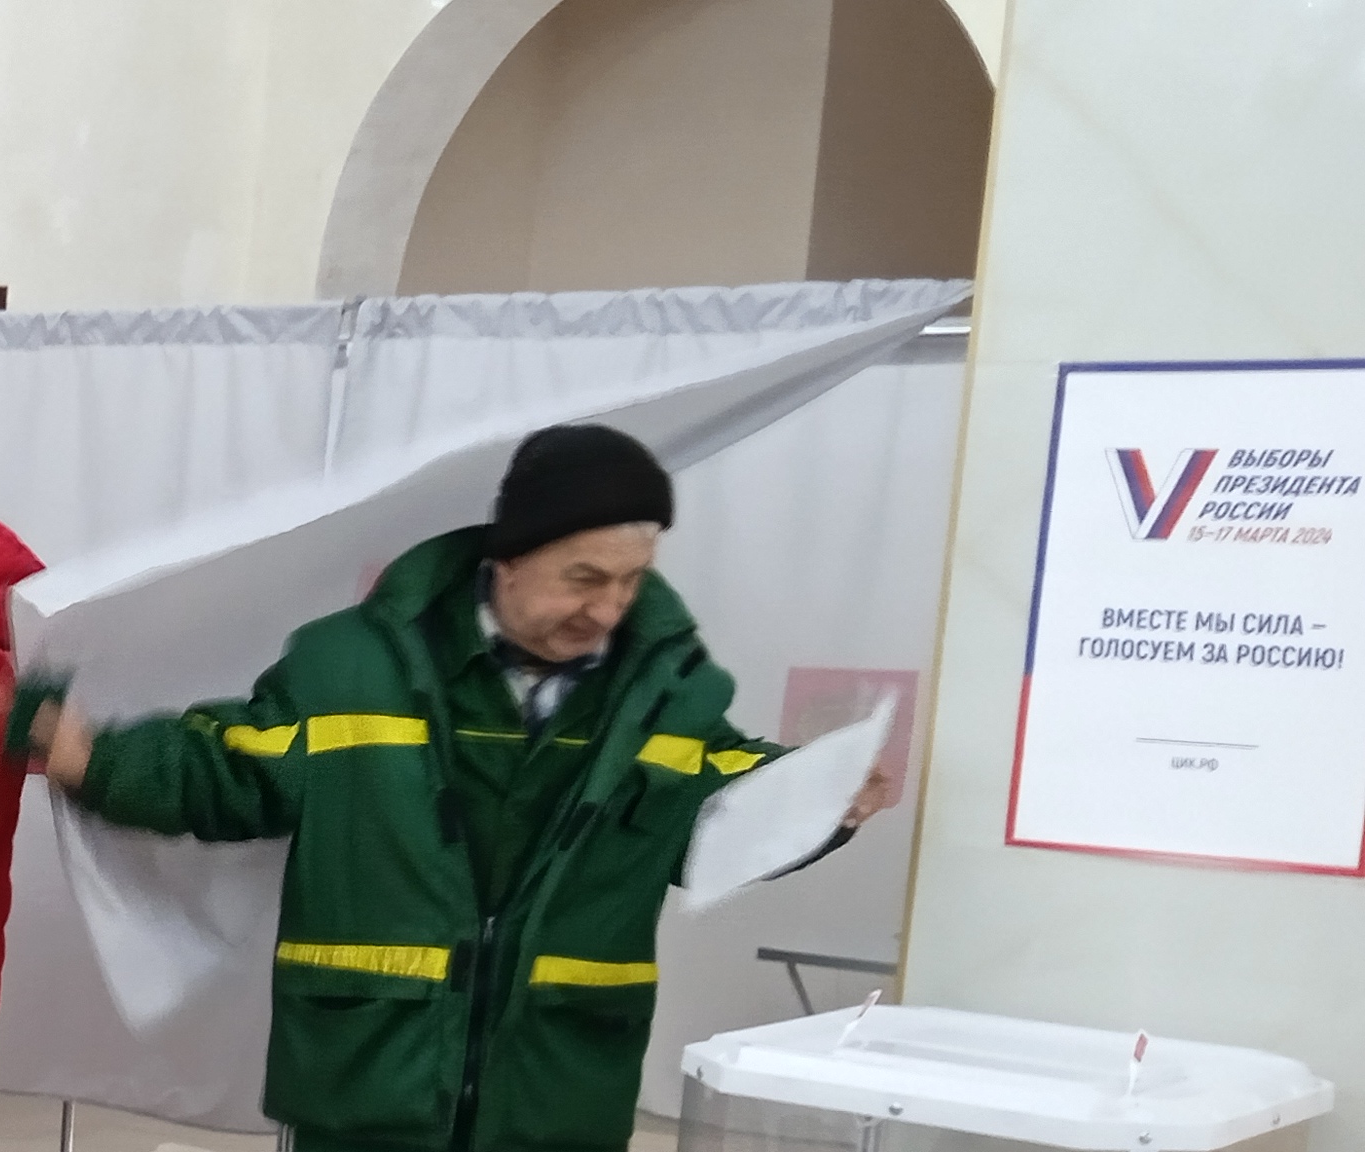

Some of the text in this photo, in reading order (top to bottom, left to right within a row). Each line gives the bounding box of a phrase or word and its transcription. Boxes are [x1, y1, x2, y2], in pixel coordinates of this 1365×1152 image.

[1227, 449, 1334, 469] ВЫБОРЫ
[1212, 475, 1362, 497] ПРЕЗИДЕНТА
[1198, 501, 1293, 520] РОССИИ
[1233, 527, 1290, 543] МАРТА
[1291, 527, 1333, 545] 2024
[1101, 608, 1188, 631] ВМЕСТЕ
[1195, 611, 1235, 632] МЫ
[1242, 613, 1304, 635] СИЛА
[1078, 637, 1344, 669] ГОЛОСУЕМ ЗА РОССИЮ!
